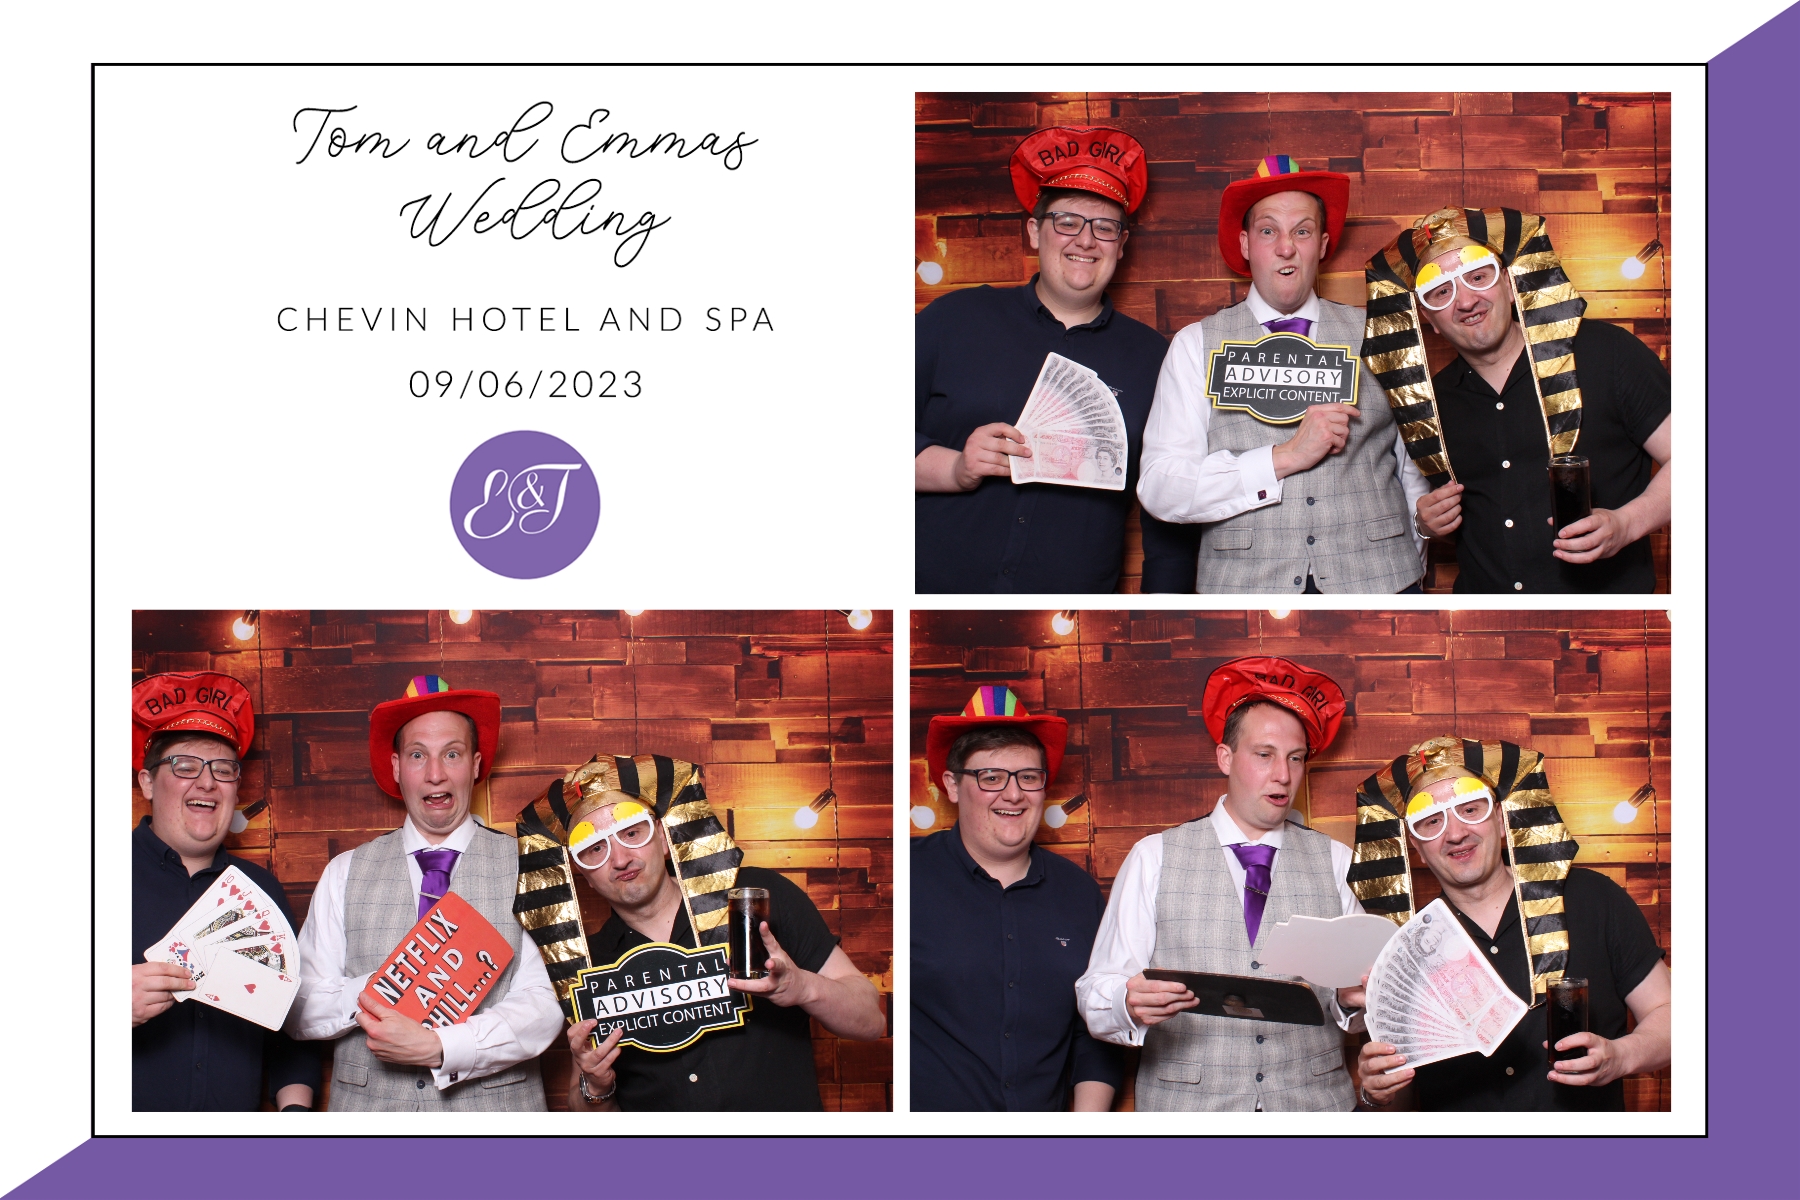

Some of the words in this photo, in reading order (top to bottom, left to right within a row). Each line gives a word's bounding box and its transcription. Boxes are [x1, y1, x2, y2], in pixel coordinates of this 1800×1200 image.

[1038, 141, 1080, 167] BAD
[1089, 141, 1127, 167] GIRL
[1228, 351, 1342, 367] PARENTAL
[1225, 367, 1342, 386] ADVISORY
[1223, 386, 1277, 400] EXPLICIT
[1279, 389, 1341, 403] CONTENT
[145, 687, 186, 716] BAD
[195, 687, 233, 711] GIRL
[372, 908, 459, 1006] NETFLIX
[414, 948, 464, 1010] AND
[590, 958, 724, 994] PARENTAL
[596, 976, 727, 1017] ADVISORY
[598, 1014, 659, 1036] EXPLICIT
[662, 1001, 732, 1024] CONTENT
